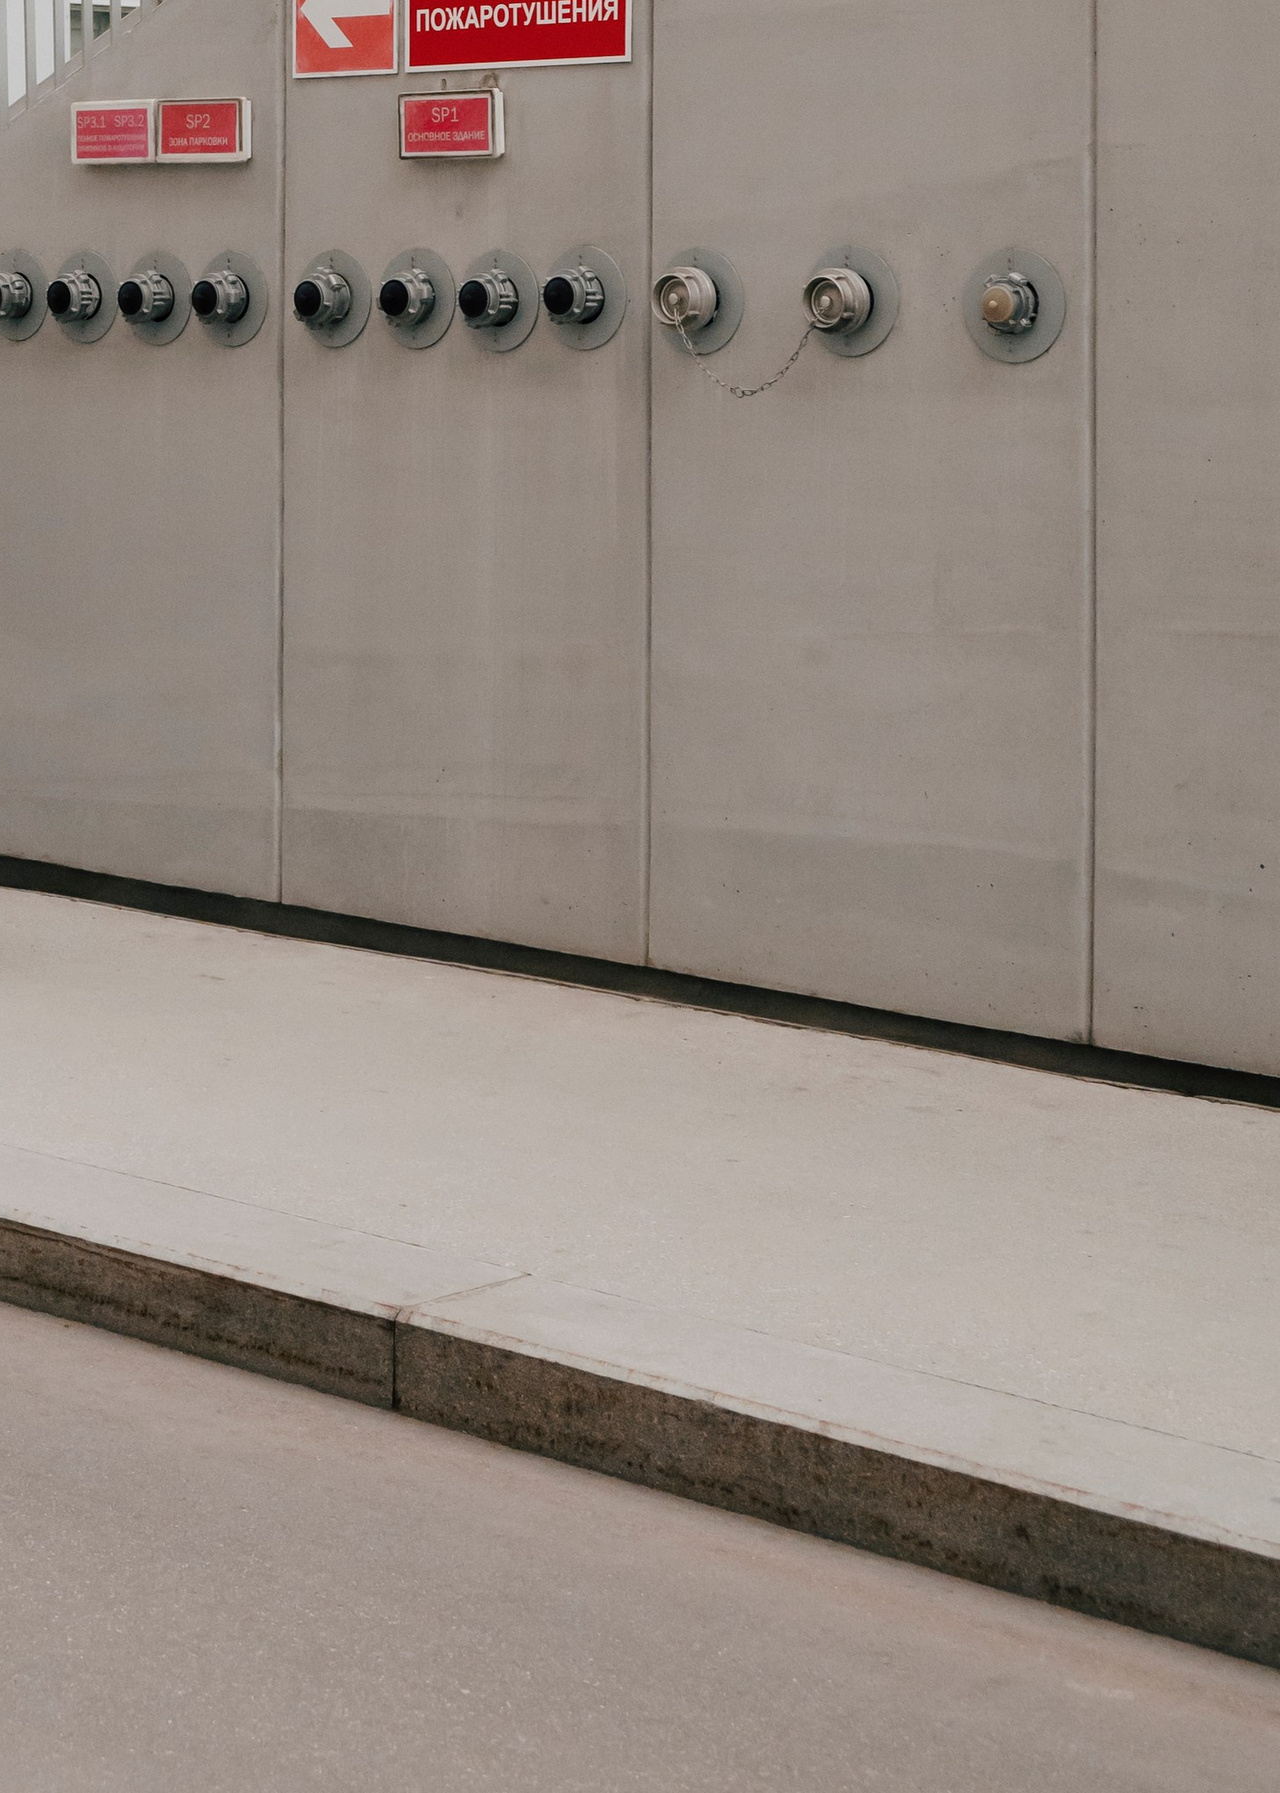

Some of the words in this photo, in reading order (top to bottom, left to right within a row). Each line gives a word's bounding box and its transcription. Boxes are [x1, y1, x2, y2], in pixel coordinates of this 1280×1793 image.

[77, 116, 106, 129] SP3.1
[114, 114, 145, 128] SP3.2
[185, 113, 211, 130] SP2
[431, 106, 459, 123] SP1
[168, 137, 188, 147] ЗОНА
[189, 136, 228, 146] ПАРКОВКИ
[407, 131, 451, 142] ОСНОВНОЕ
[452, 130, 486, 142] ЗДАНИЕ
